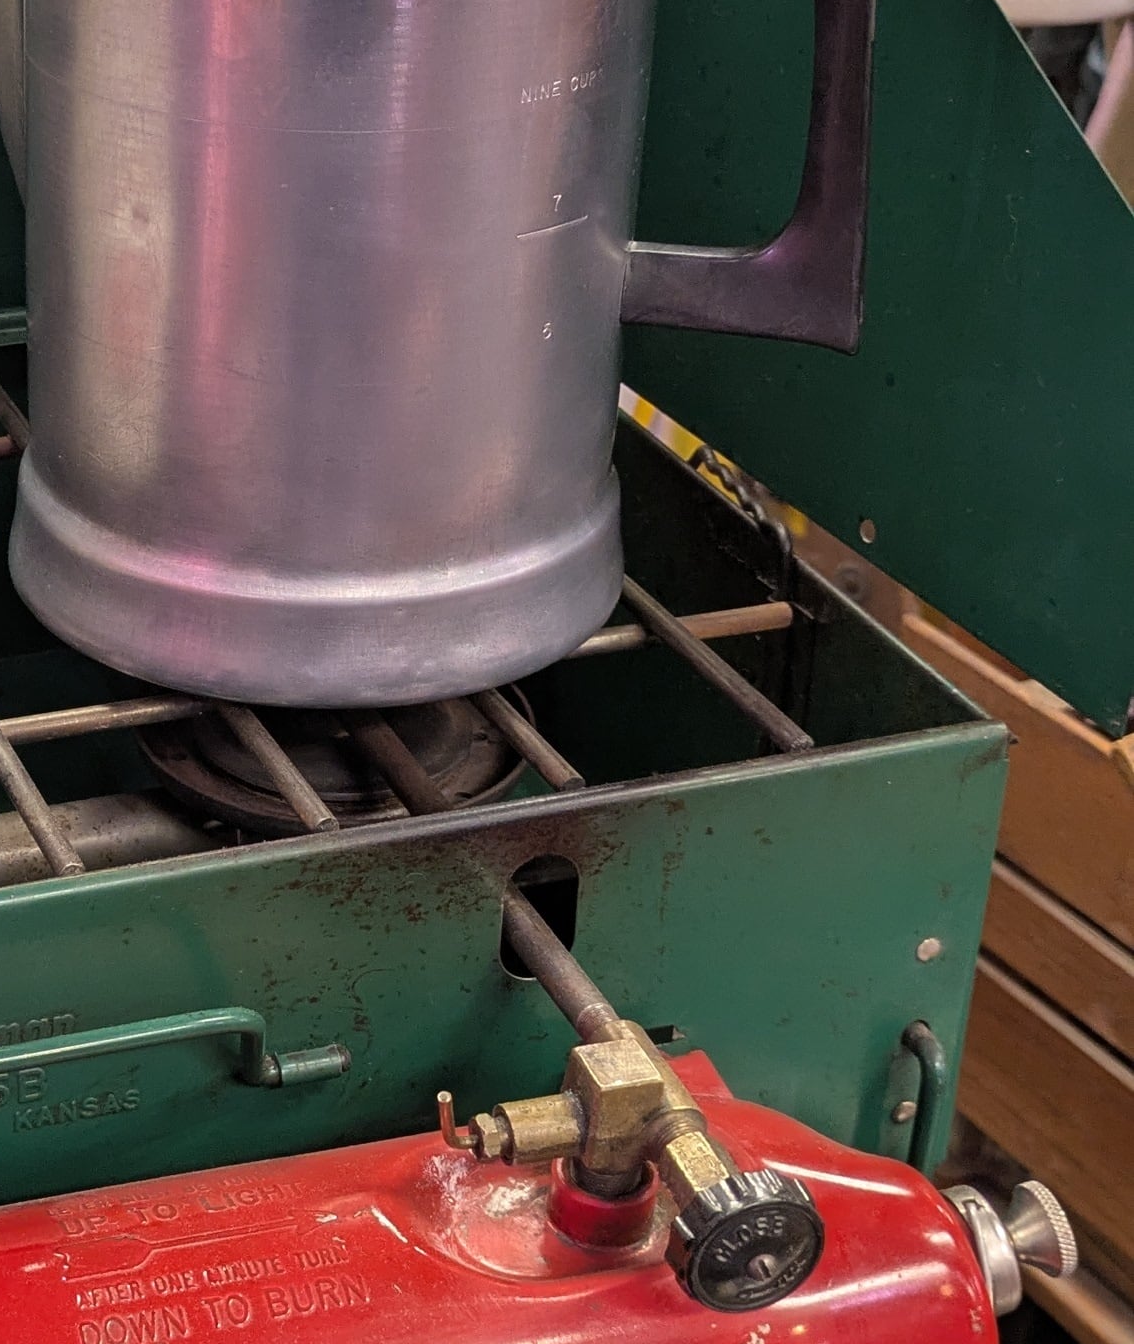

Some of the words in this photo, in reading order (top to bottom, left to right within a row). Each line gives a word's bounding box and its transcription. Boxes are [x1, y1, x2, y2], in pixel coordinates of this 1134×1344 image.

[520, 79, 563, 104] NINE
[553, 193, 563, 212] 7
[13, 1088, 142, 1133] KANSAS
[57, 1217, 106, 1237] UP
[127, 1203, 178, 1226] TO
[196, 1181, 307, 1214] LIGHT
[715, 1213, 787, 1263] CLOSE
[76, 1279, 146, 1310] AFTER
[151, 1267, 198, 1295] ONE
[201, 1255, 286, 1286] MINUTE
[295, 1244, 350, 1272] TURN
[200, 1291, 251, 1329] TO
[263, 1272, 371, 1320] BURN
